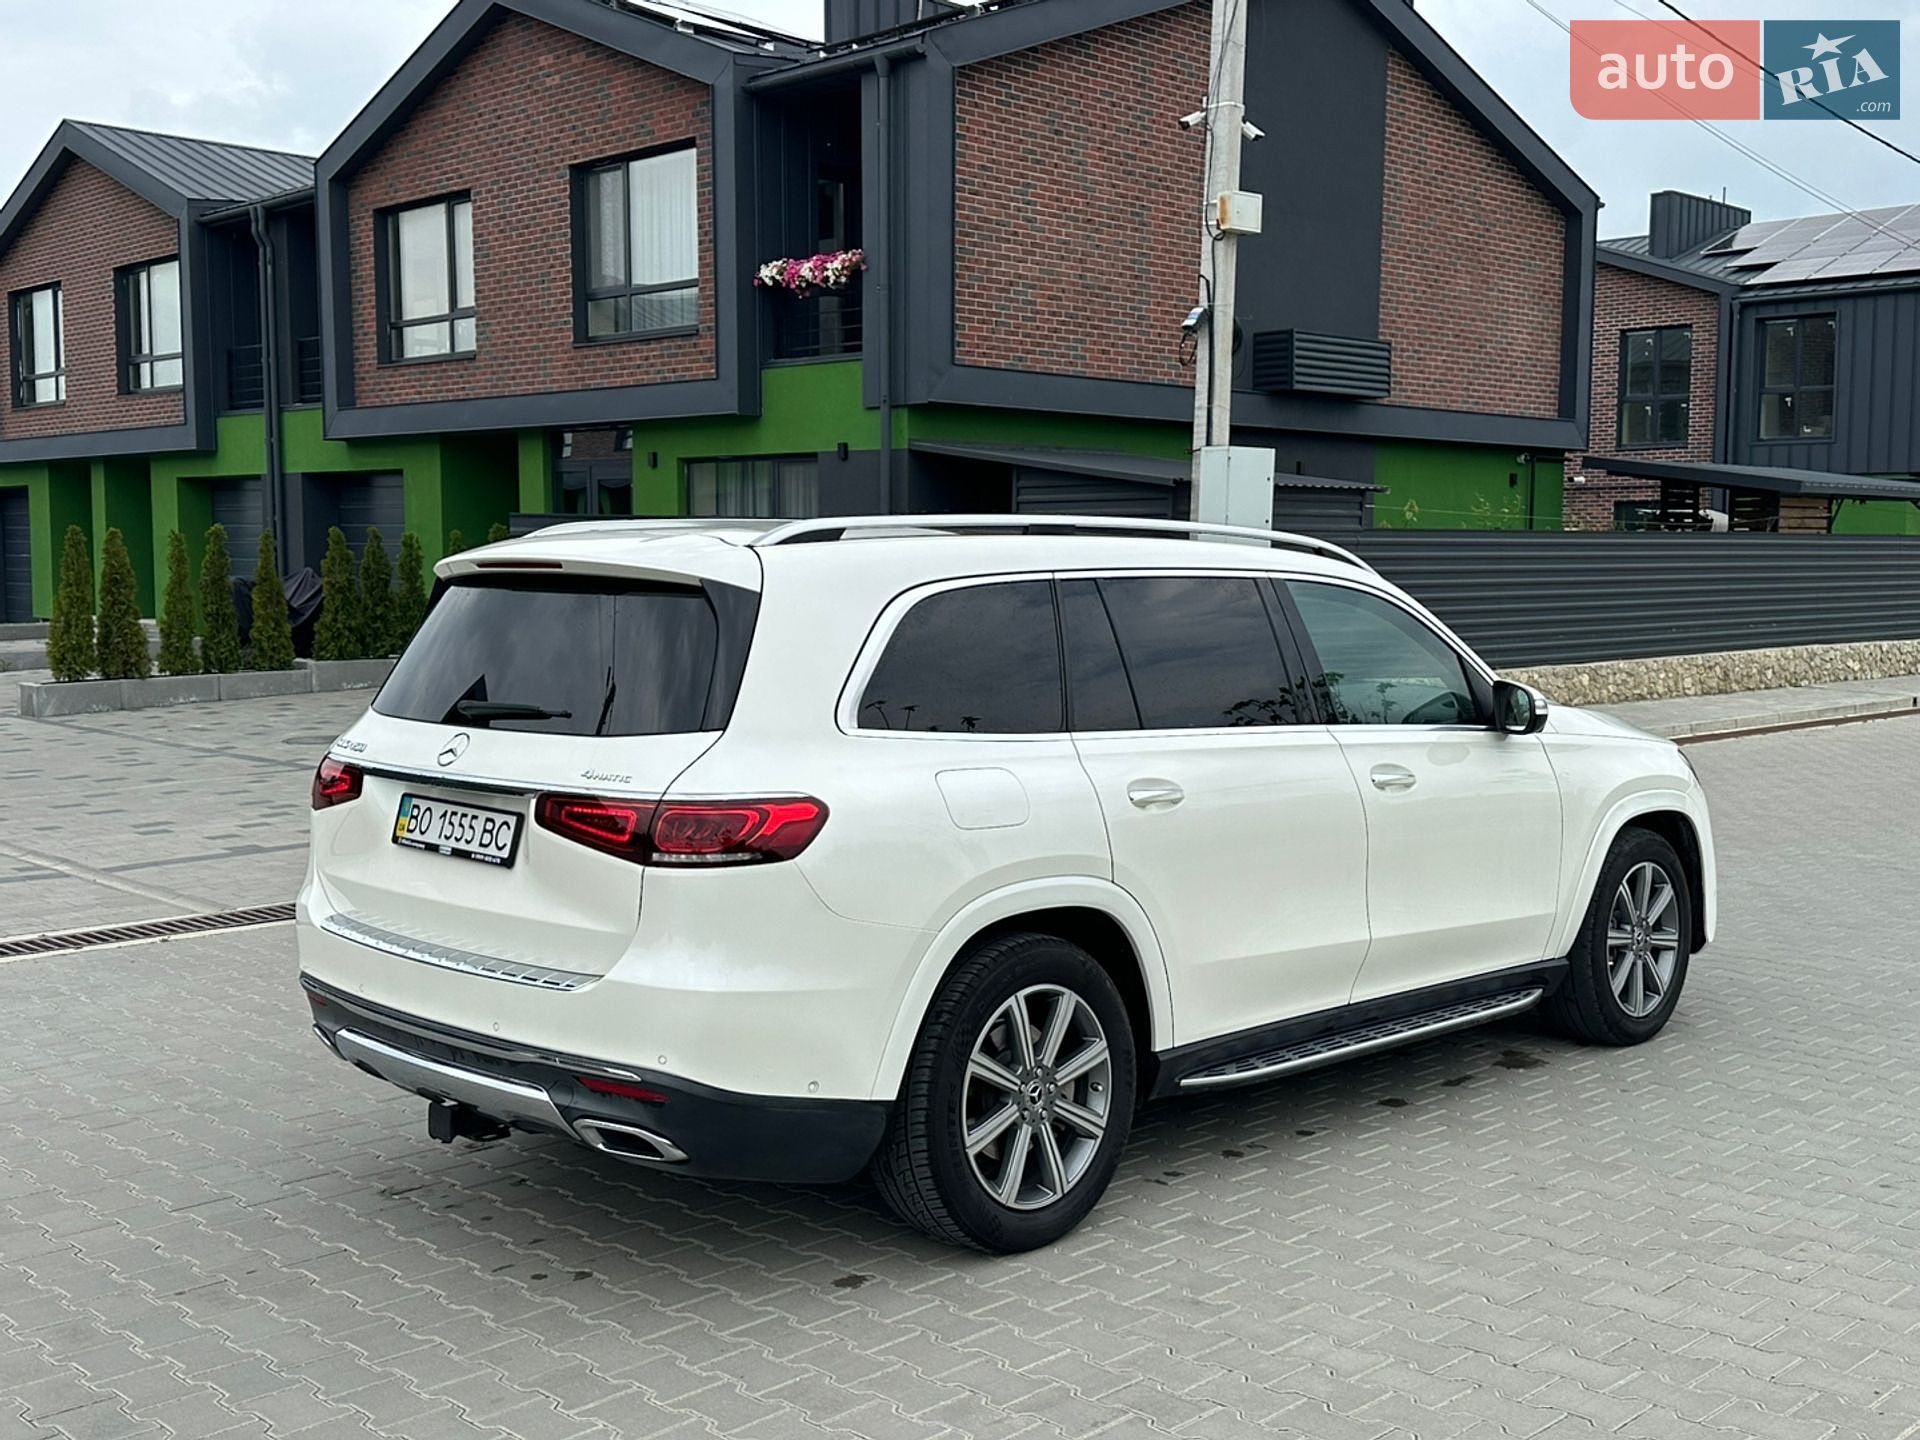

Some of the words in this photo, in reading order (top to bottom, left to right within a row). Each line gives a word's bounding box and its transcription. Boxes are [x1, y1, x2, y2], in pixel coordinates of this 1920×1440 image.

[406, 804, 433, 836] BO
[438, 809, 479, 845] 1555
[479, 817, 511, 851] BC
